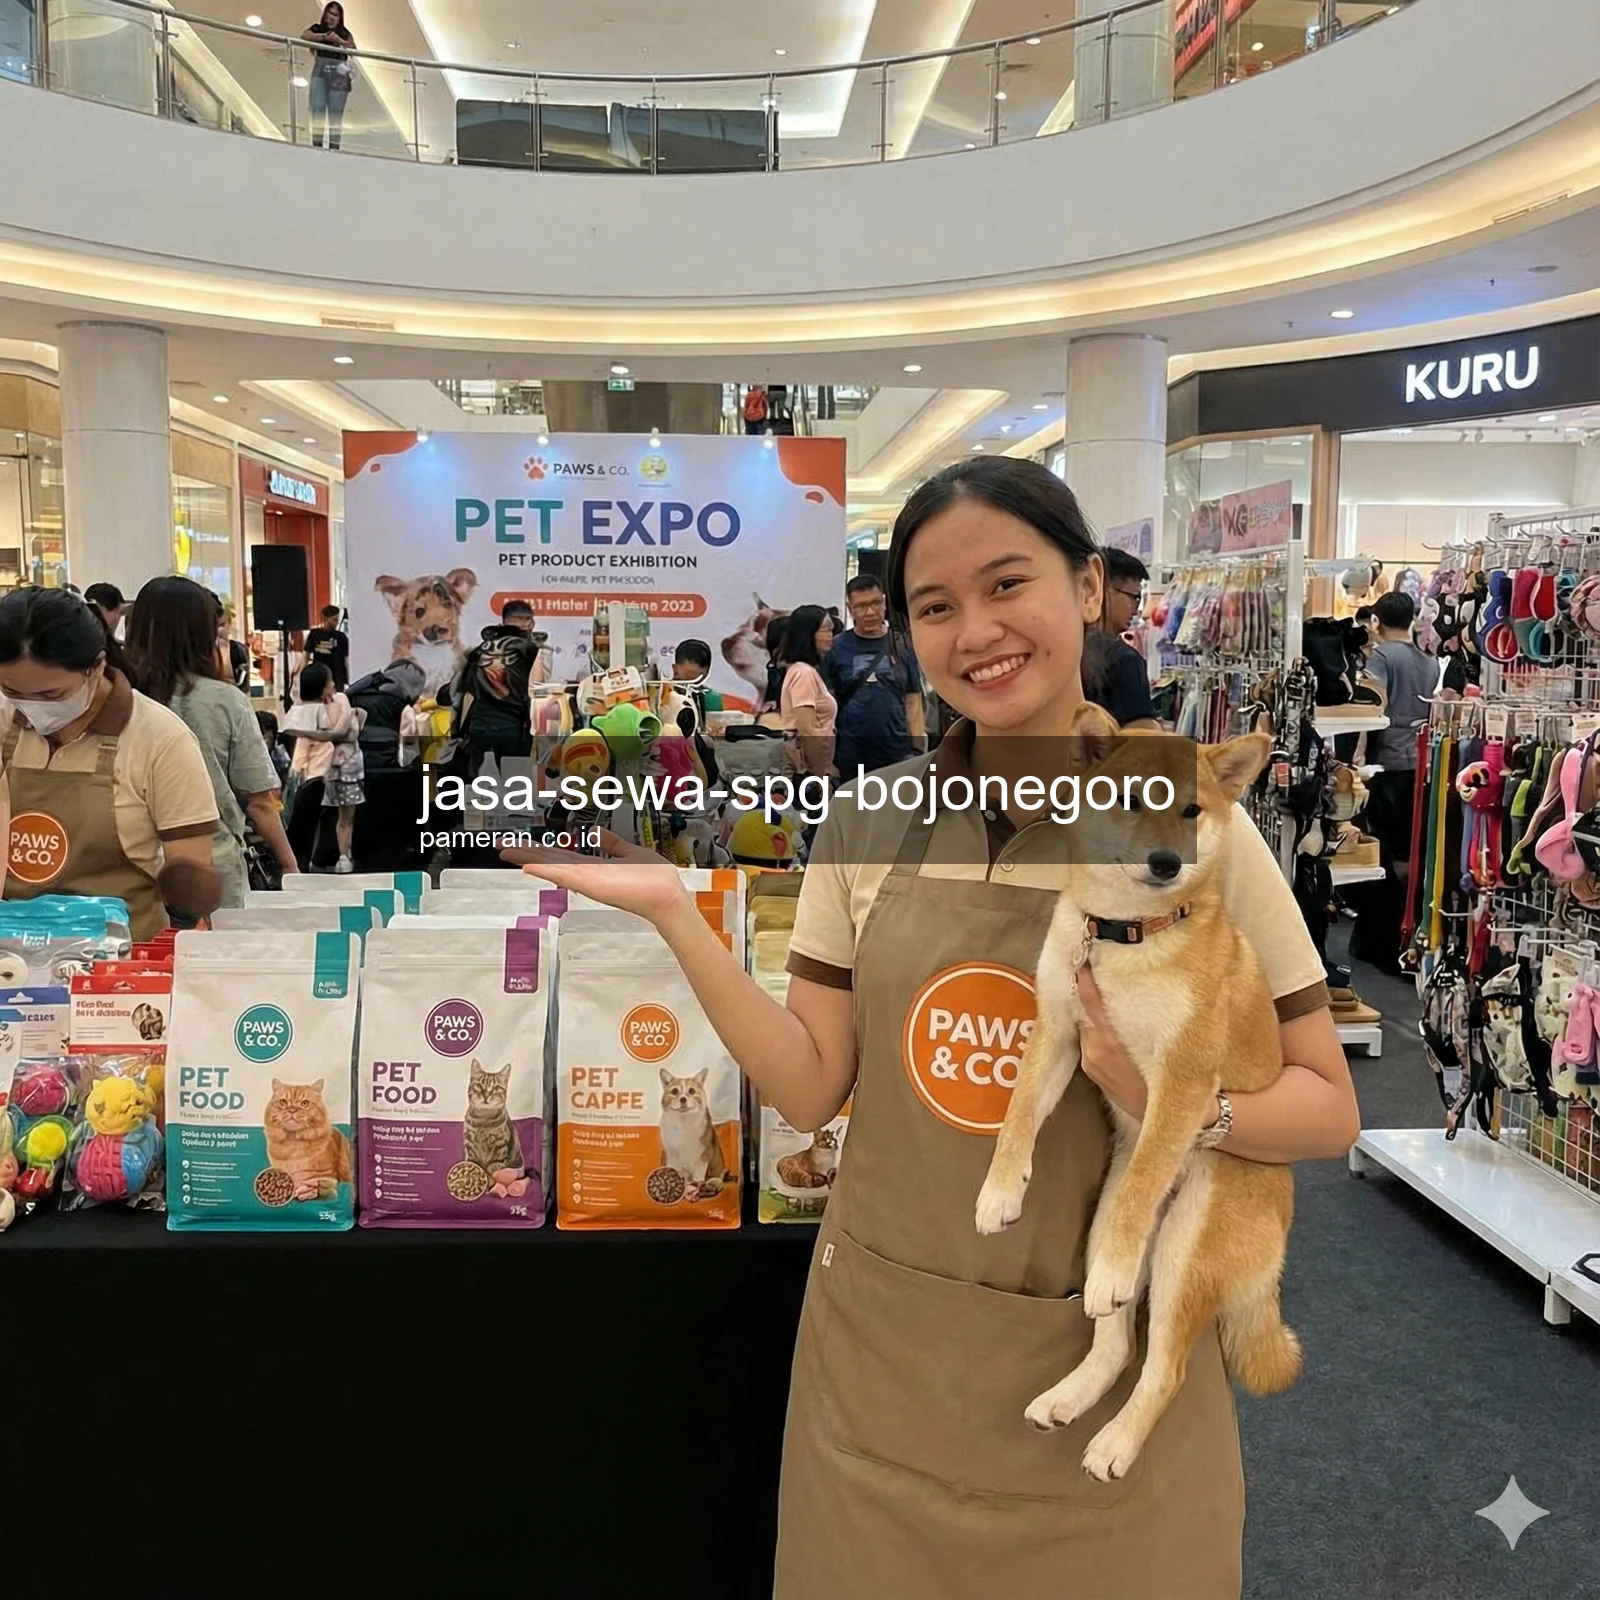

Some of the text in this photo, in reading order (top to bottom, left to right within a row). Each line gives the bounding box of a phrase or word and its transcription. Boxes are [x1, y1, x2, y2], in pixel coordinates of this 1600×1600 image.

[1405, 346, 1539, 403] KURU
[553, 463, 630, 476] PAWS & CO.
[455, 498, 742, 547] PET EXPO
[499, 554, 698, 568] PET PRODUCT EXHIBITION
[661, 600, 694, 612] 2023
[10, 831, 60, 850] PAWS
[11, 848, 55, 866] & CO.
[242, 1021, 284, 1034] PAWS
[434, 1016, 476, 1028] PAWS
[630, 1021, 671, 1034] PAWS
[928, 1008, 1037, 1051] PAWS
[243, 1035, 282, 1047] & CO.
[435, 1029, 473, 1041] & CO.
[631, 1034, 669, 1046] & CO.
[372, 1062, 421, 1082] PET
[930, 1045, 960, 1081] &
[180, 1066, 229, 1087] PET
[571, 1067, 619, 1087] PET
[180, 1091, 245, 1110] FOOD
[372, 1086, 437, 1104] FOOD
[571, 1091, 644, 1109] CAPFE
